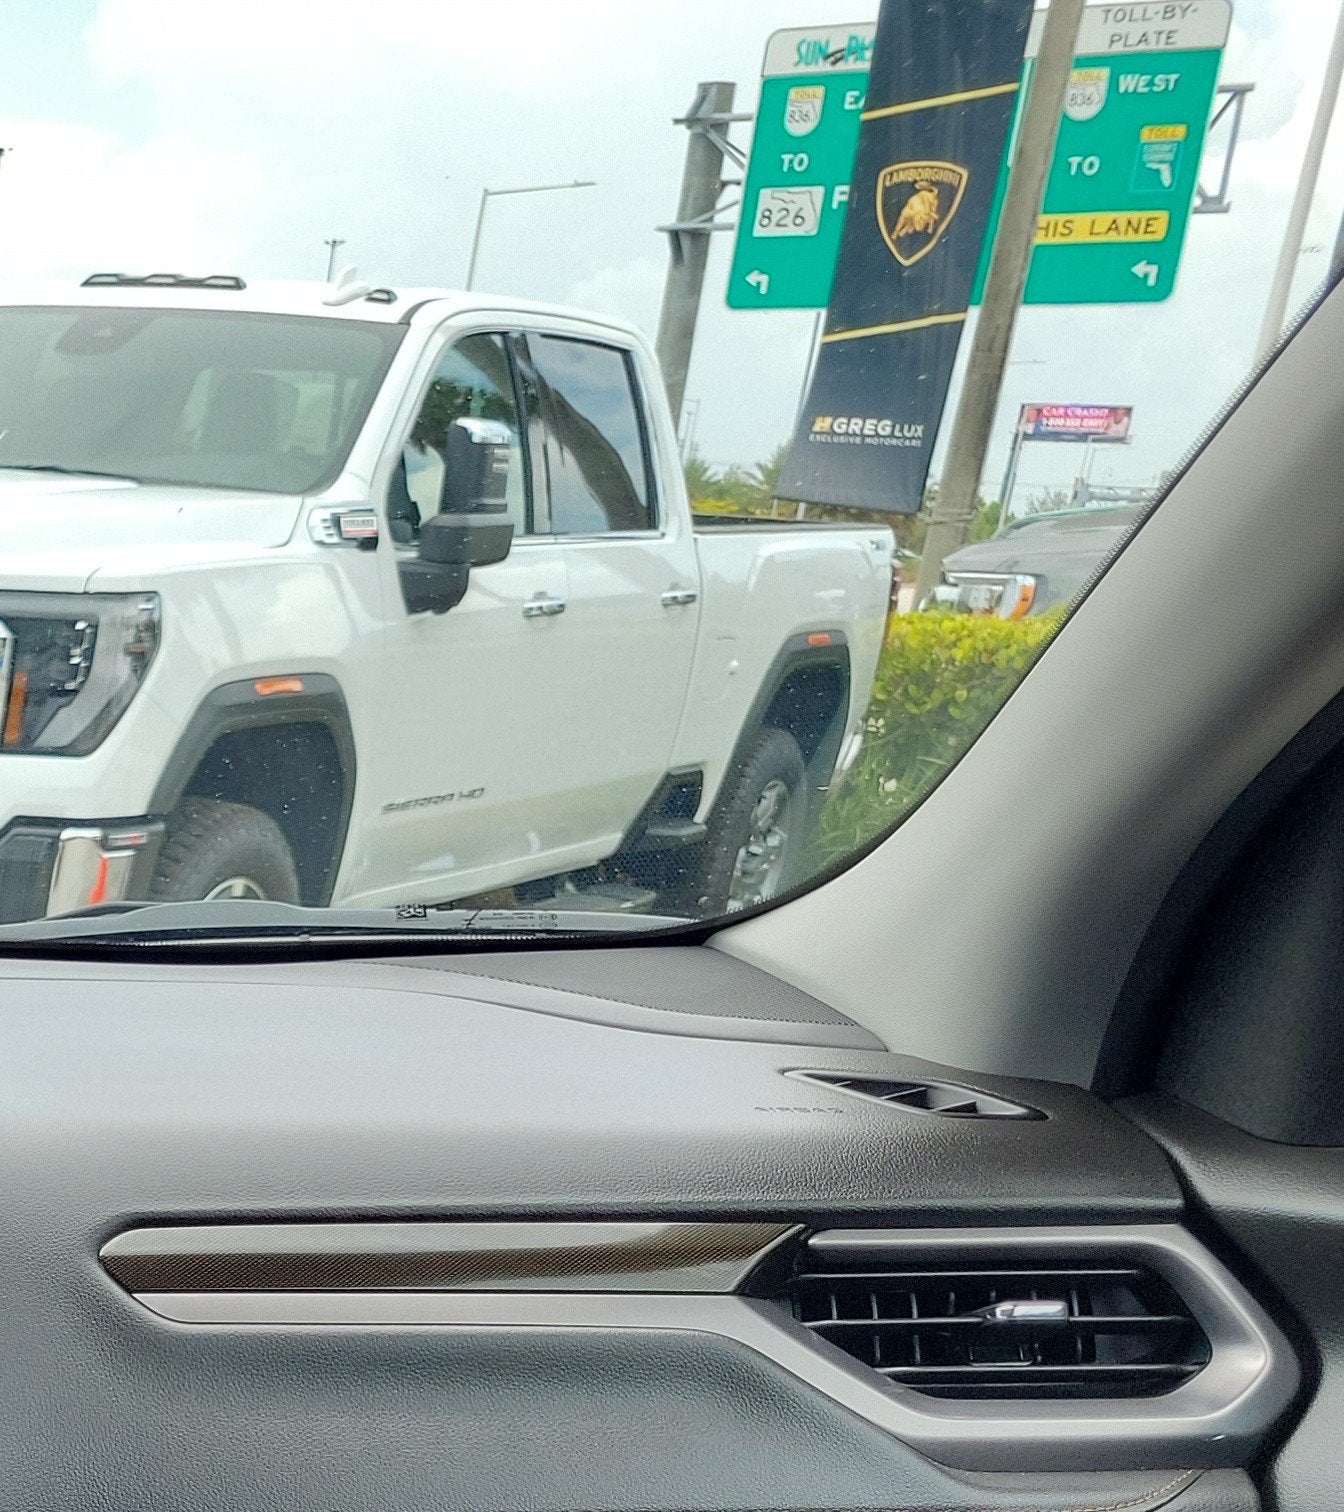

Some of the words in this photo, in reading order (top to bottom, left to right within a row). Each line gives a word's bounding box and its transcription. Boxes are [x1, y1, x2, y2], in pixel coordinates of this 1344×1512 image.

[1108, 30, 1178, 49] PLATE
[1118, 73, 1180, 93] WEST
[781, 153, 809, 173] TO
[1067, 155, 1100, 176] TO
[758, 207, 805, 228] 826
[1035, 219, 1073, 238] HIS
[1089, 216, 1159, 235] LANE
